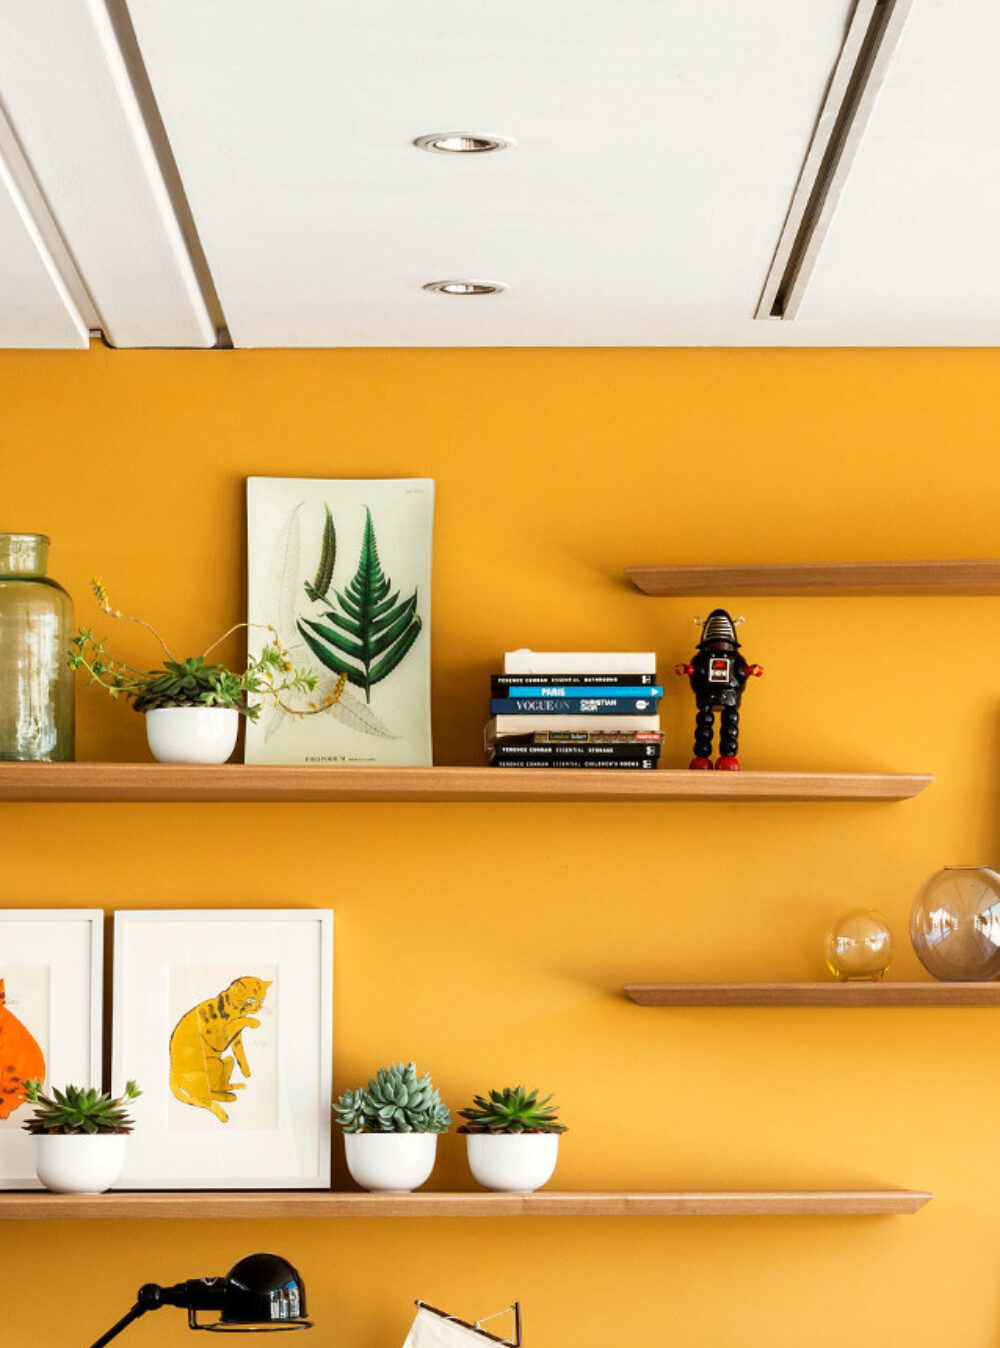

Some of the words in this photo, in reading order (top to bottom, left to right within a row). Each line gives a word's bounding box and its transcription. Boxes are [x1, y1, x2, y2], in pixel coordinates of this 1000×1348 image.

[541, 688, 566, 696] PARIS
[516, 700, 554, 710] VOGUE
[554, 700, 570, 710] ON
